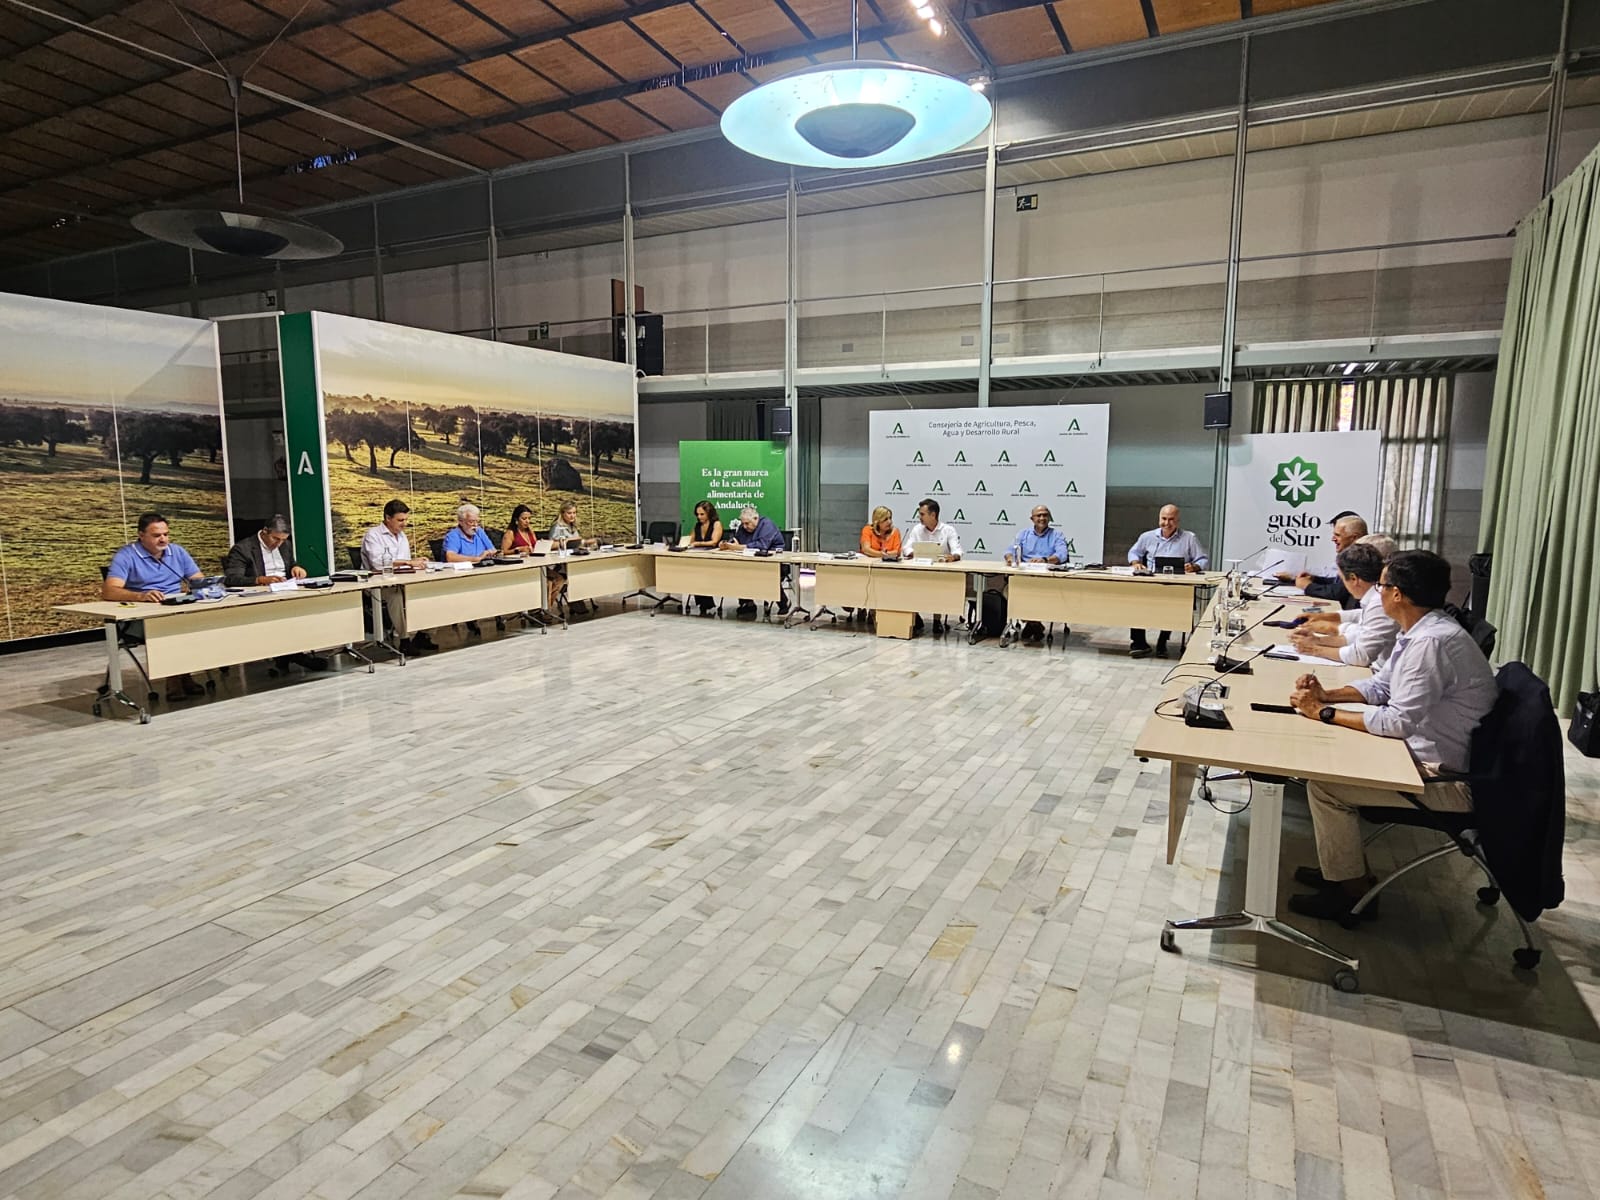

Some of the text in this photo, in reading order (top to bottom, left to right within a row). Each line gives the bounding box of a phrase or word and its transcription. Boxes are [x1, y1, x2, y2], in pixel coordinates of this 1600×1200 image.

[929, 421, 962, 430] Consejería
[973, 421, 1012, 430] Agricultura,
[1014, 420, 1036, 429] Pesca,
[943, 430, 960, 438] Agua
[702, 468, 769, 479] Es la gran marca
[710, 479, 761, 488] de la calidad
[707, 490, 764, 498] alimentaria de
[1267, 512, 1321, 533] gusto
[1269, 528, 1320, 547] del Sur
